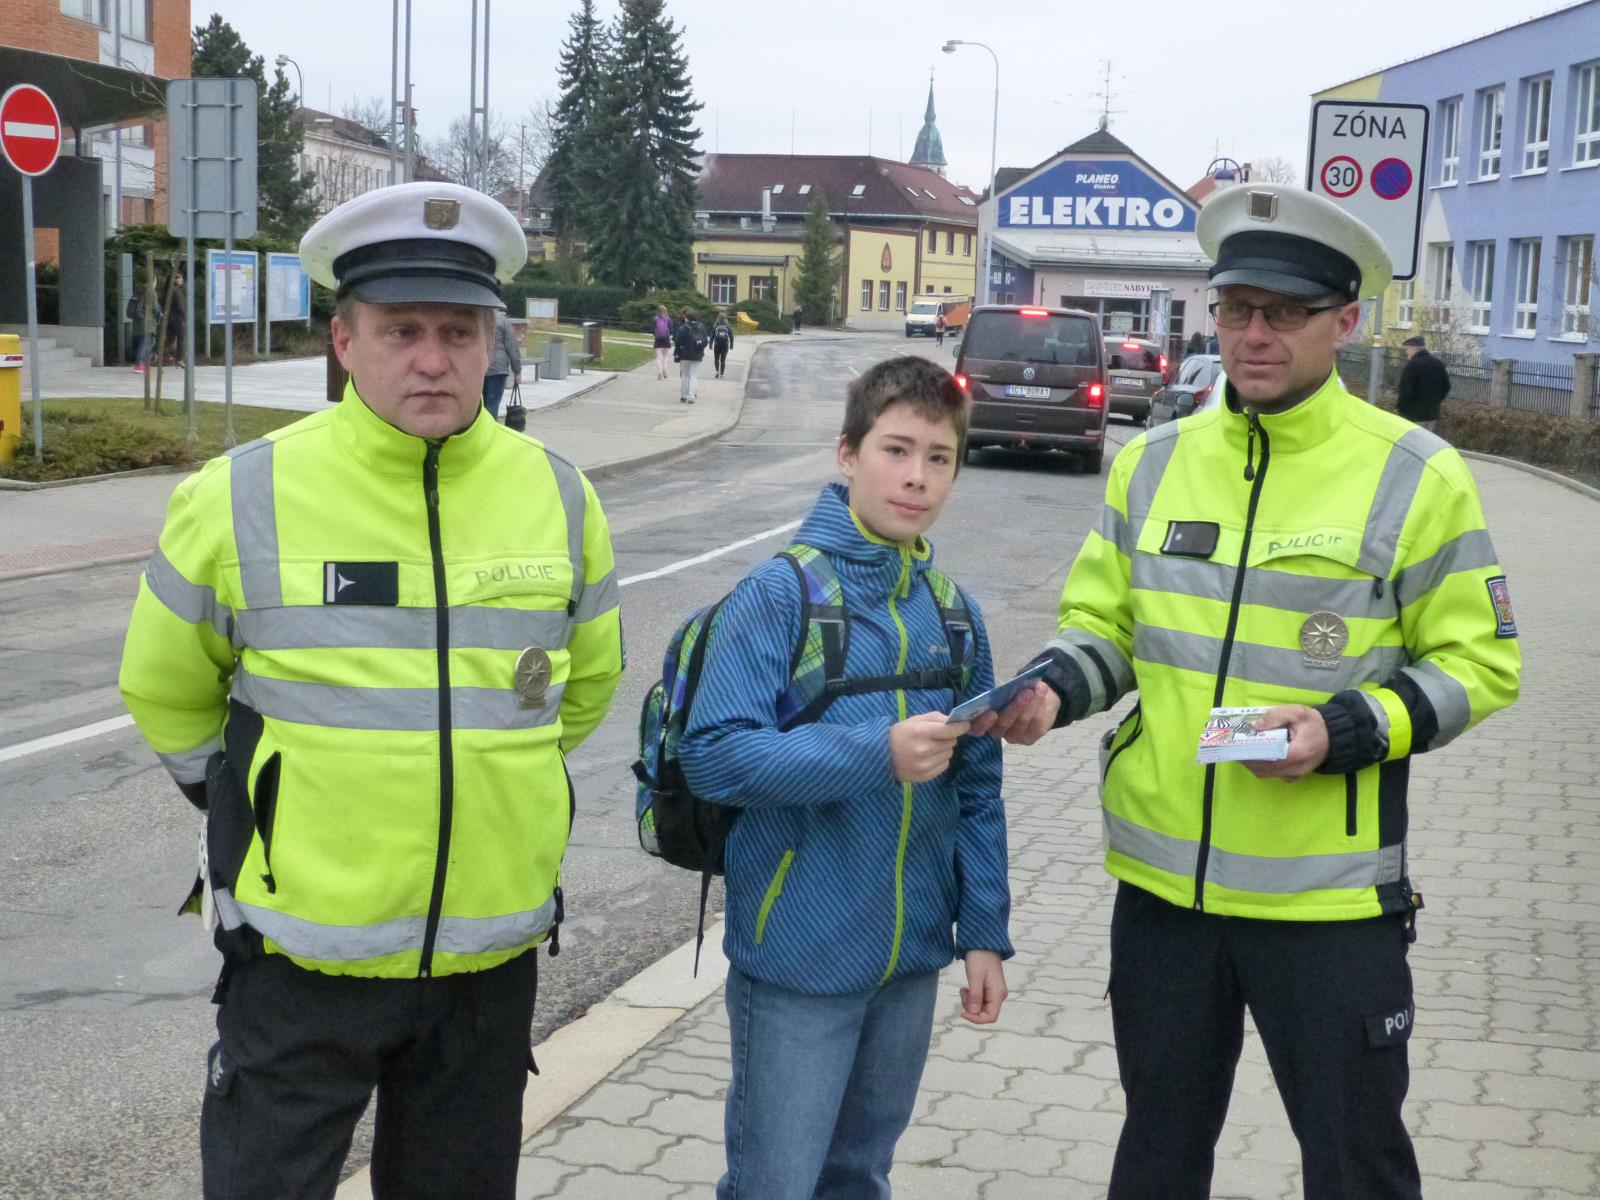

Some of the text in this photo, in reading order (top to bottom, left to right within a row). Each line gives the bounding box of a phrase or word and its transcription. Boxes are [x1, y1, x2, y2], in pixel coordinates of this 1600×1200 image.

[1333, 110, 1406, 139] ZÓNA
[1075, 174, 1119, 184] PLANEO
[1328, 166, 1355, 187] 30
[1010, 196, 1184, 228] ELEKTRO
[475, 564, 556, 586] POLICIE
